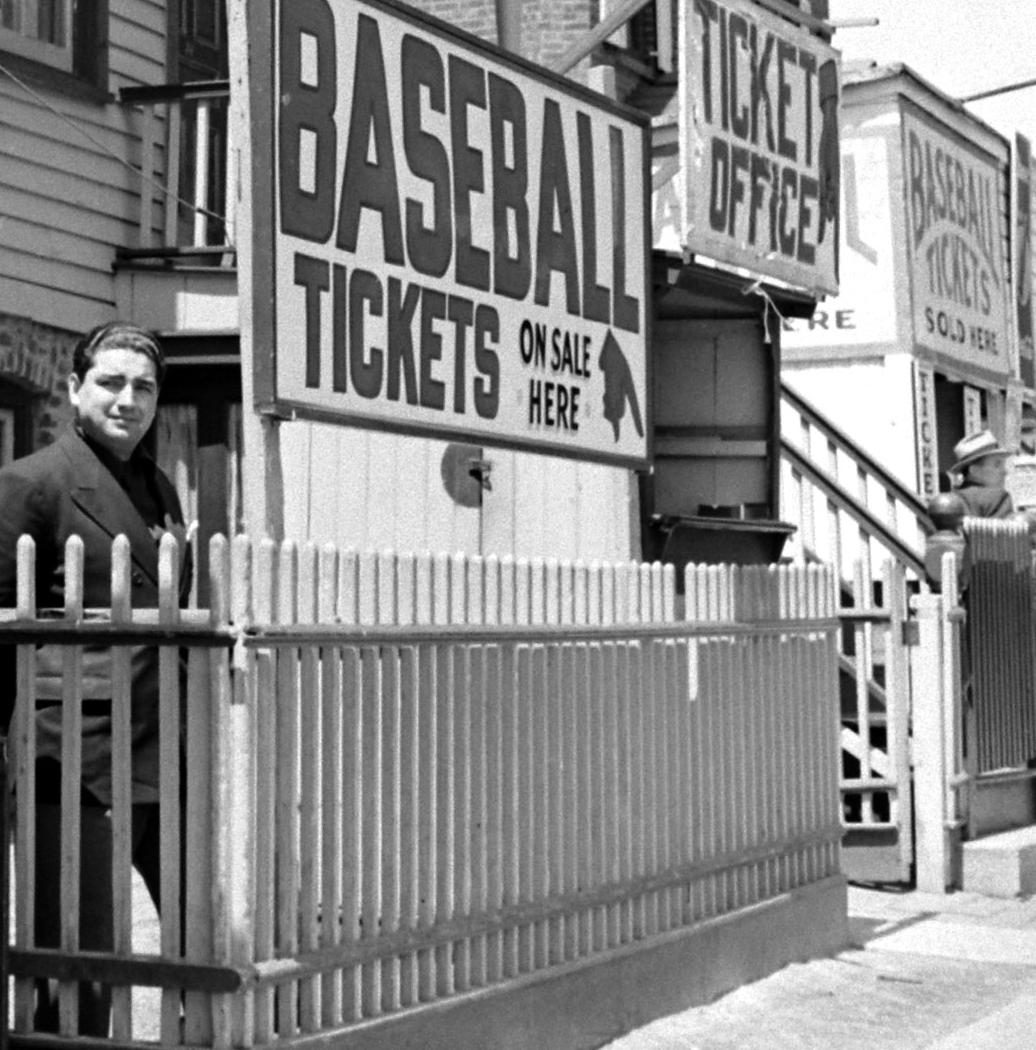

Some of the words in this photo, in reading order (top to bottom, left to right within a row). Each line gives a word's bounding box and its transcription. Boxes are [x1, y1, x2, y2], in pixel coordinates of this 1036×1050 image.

[709, 135, 819, 265] OFFICE
[909, 129, 1000, 289] BASEBALL
[926, 234, 991, 316] TICKETS
[294, 253, 500, 420] TICKETS
[520, 319, 546, 370] ON
[550, 327, 591, 378] SALE
[925, 307, 965, 345] SOLD
[529, 379, 581, 431] HERE
